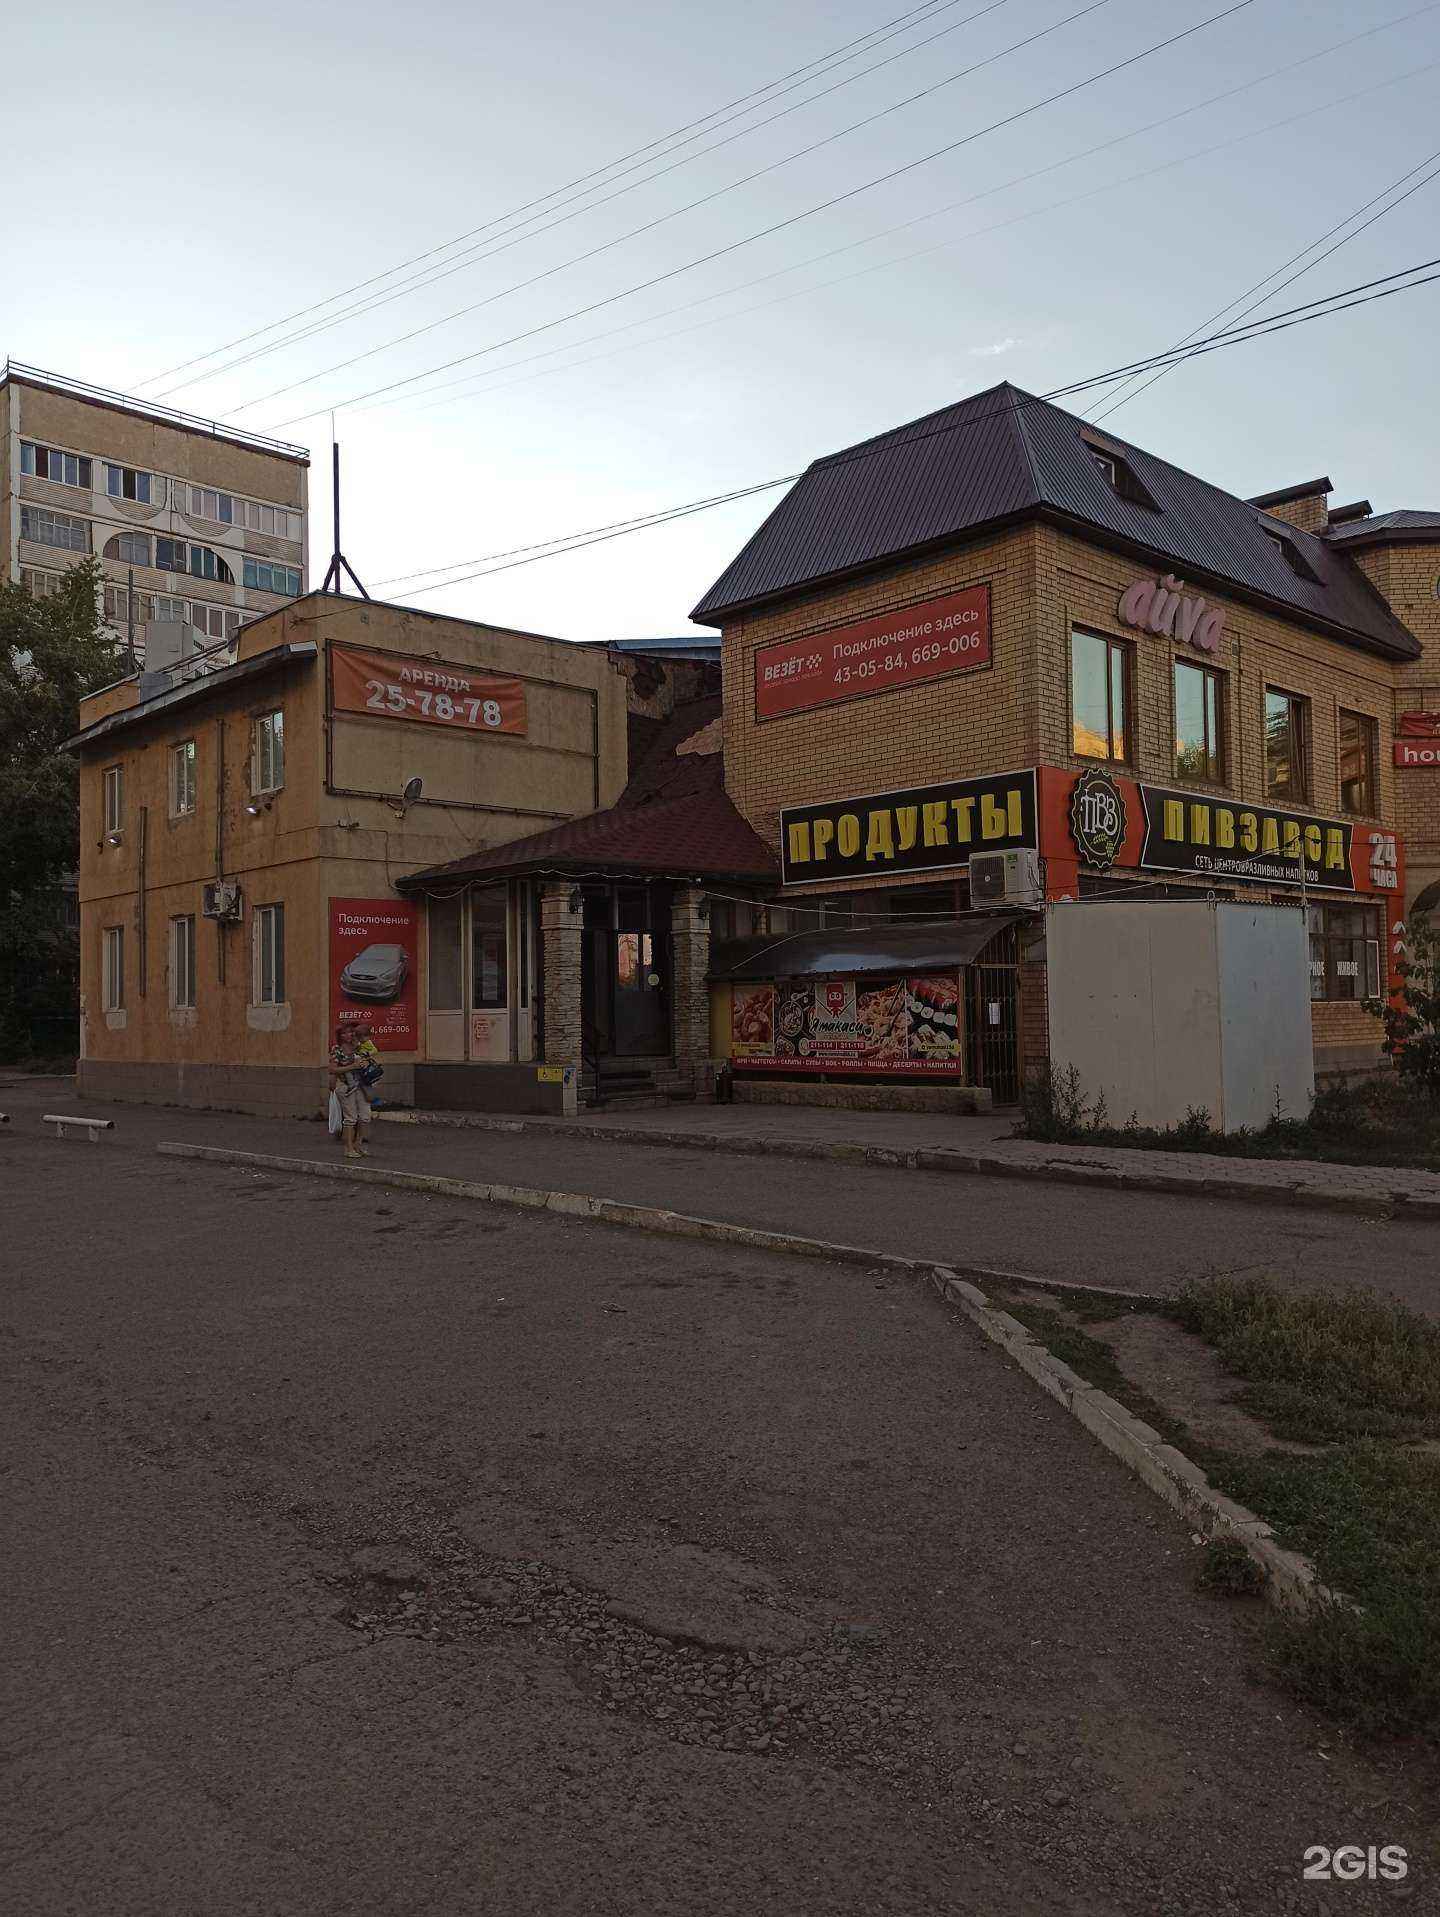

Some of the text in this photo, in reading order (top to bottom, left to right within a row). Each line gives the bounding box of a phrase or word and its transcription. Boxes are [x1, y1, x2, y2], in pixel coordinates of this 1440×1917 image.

[832, 608, 980, 660] Подключение здесь
[764, 656, 804, 681] ВЕЗЁТ
[833, 651, 909, 684] 43-05-84,
[911, 631, 981, 665] 669-006
[398, 668, 472, 693] АРЕНДА
[365, 679, 503, 727] 25-78-78
[788, 789, 1023, 864] ПРОДУКТЫ
[1080, 788, 1118, 836] ПВЗ
[1163, 799, 1345, 870] ПИВЗАВОД
[1368, 832, 1397, 867] 24
[1195, 854, 1213, 869] СЕТЬ
[1286, 867, 1319, 882] НАПКОВ
[338, 913, 409, 925] Подключение
[338, 926, 368, 936] здесь
[1337, 961, 1359, 976] ЖИВОЕ
